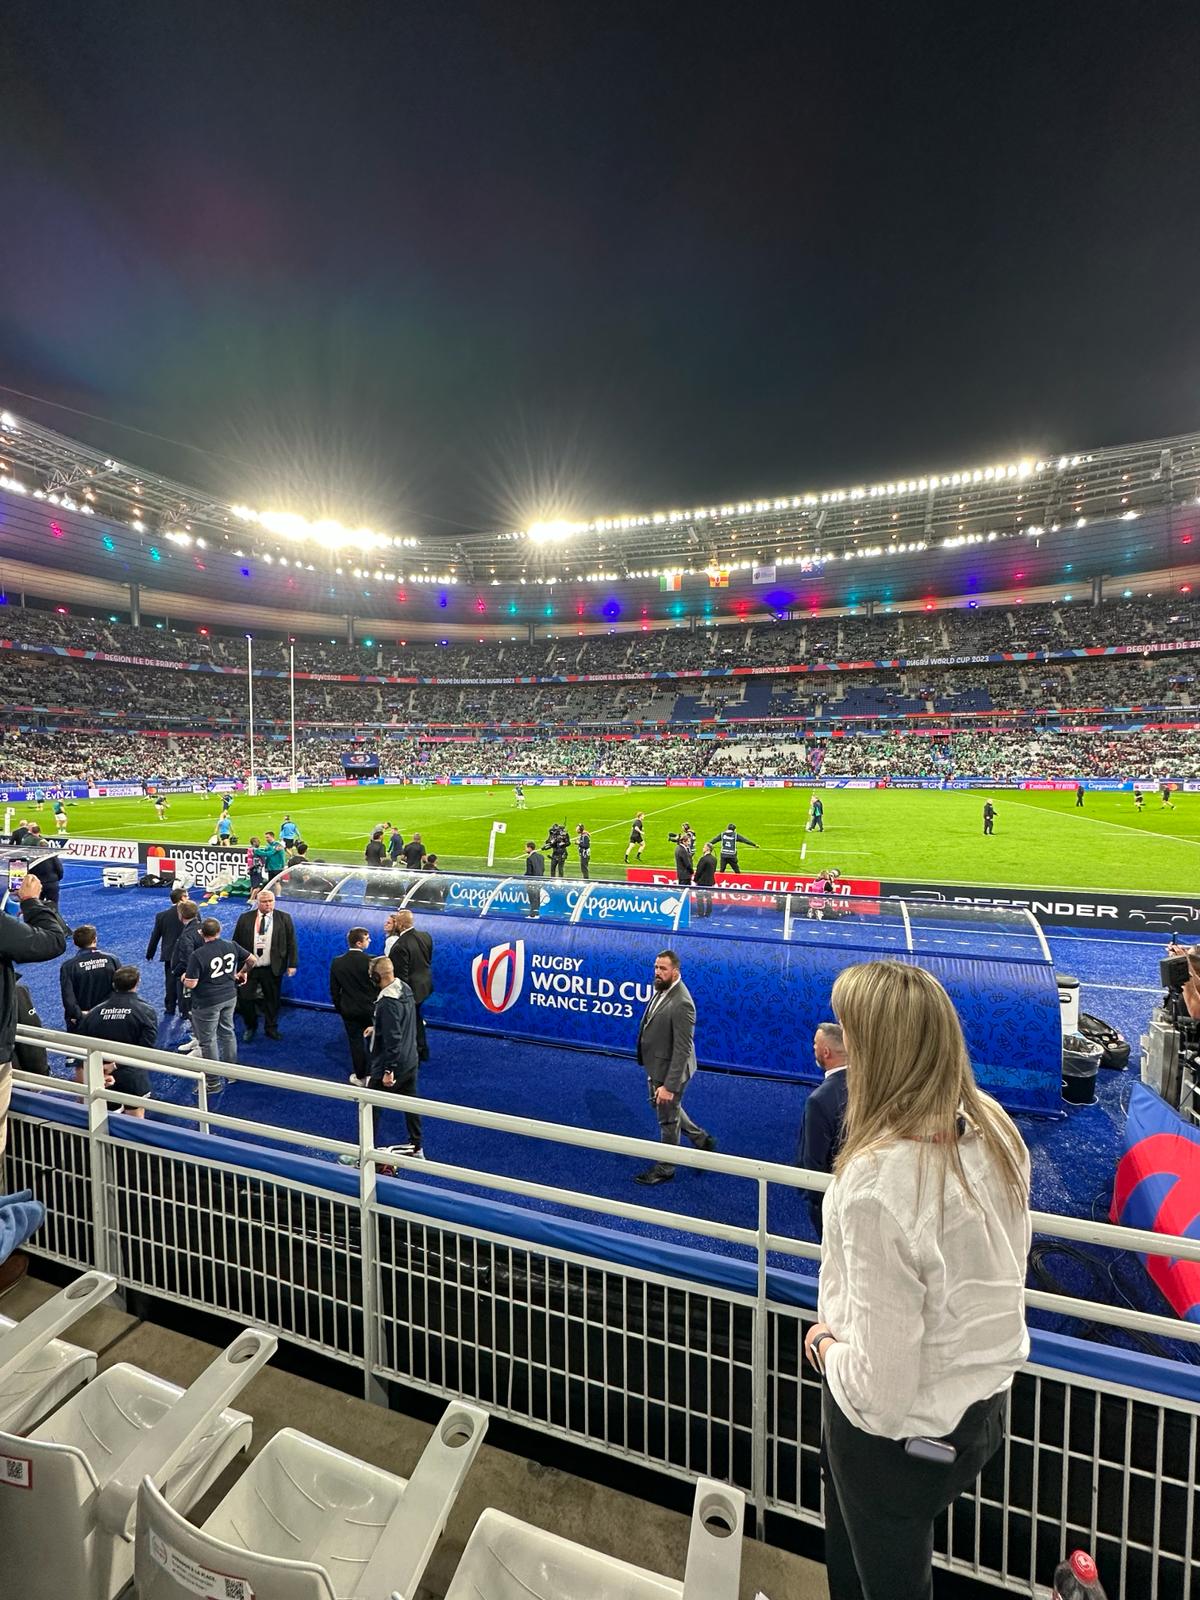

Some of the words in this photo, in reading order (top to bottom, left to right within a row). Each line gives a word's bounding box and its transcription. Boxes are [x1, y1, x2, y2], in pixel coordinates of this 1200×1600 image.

[1176, 641, 1188, 649] DE
[906, 658, 929, 667] RUGBY
[930, 657, 955, 666] WORLD
[956, 656, 970, 664] CUP
[971, 655, 990, 663] 2023
[26, 790, 77, 801] #EvNZL
[66, 843, 107, 857] SUPER
[109, 844, 136, 859] TRY
[169, 848, 248, 863] mastercar
[210, 953, 235, 979] 23
[531, 954, 583, 972] RUGBY
[530, 971, 615, 998] WORLD
[619, 981, 656, 1003] CU
[100, 1007, 132, 1016] Emirates
[530, 992, 588, 1012] FRANCE
[591, 1001, 633, 1018] 2023
